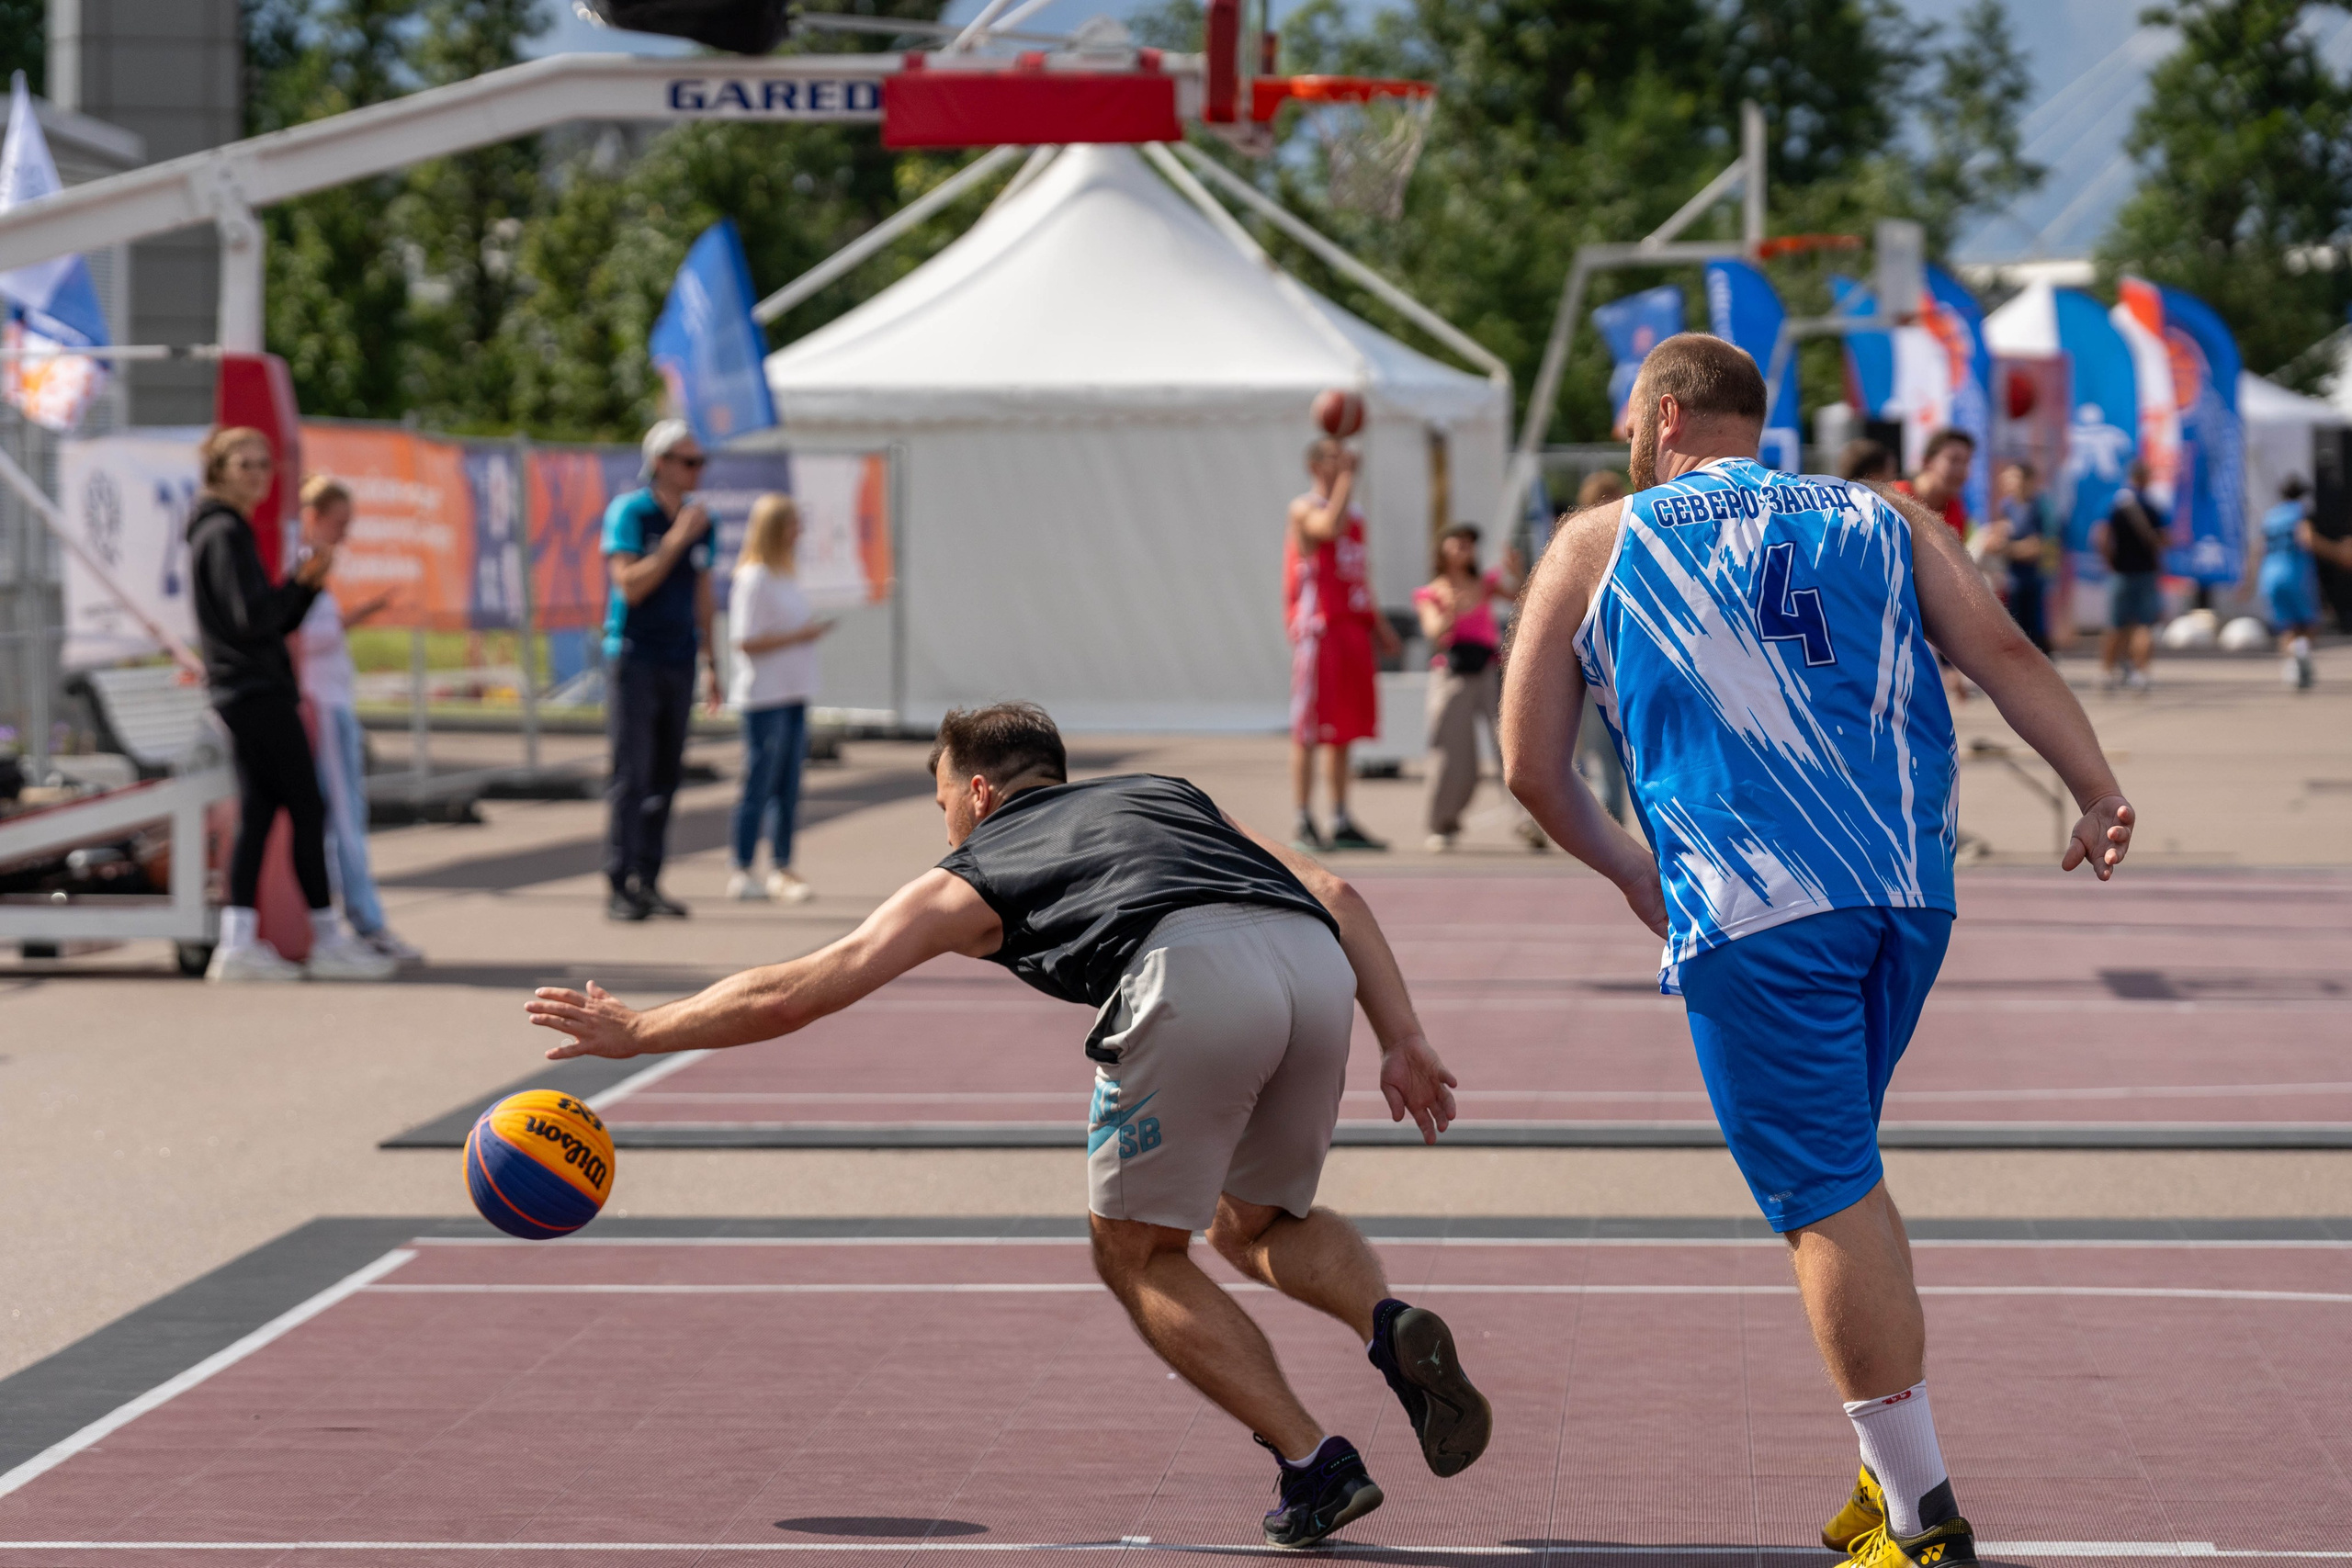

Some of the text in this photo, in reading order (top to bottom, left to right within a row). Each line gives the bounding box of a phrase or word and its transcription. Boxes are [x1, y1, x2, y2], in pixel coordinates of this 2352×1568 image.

[668, 77, 883, 112] GARED
[1754, 540, 1838, 668] 4
[525, 1116, 607, 1190] Wilson
[1118, 1116, 1162, 1159] SB
